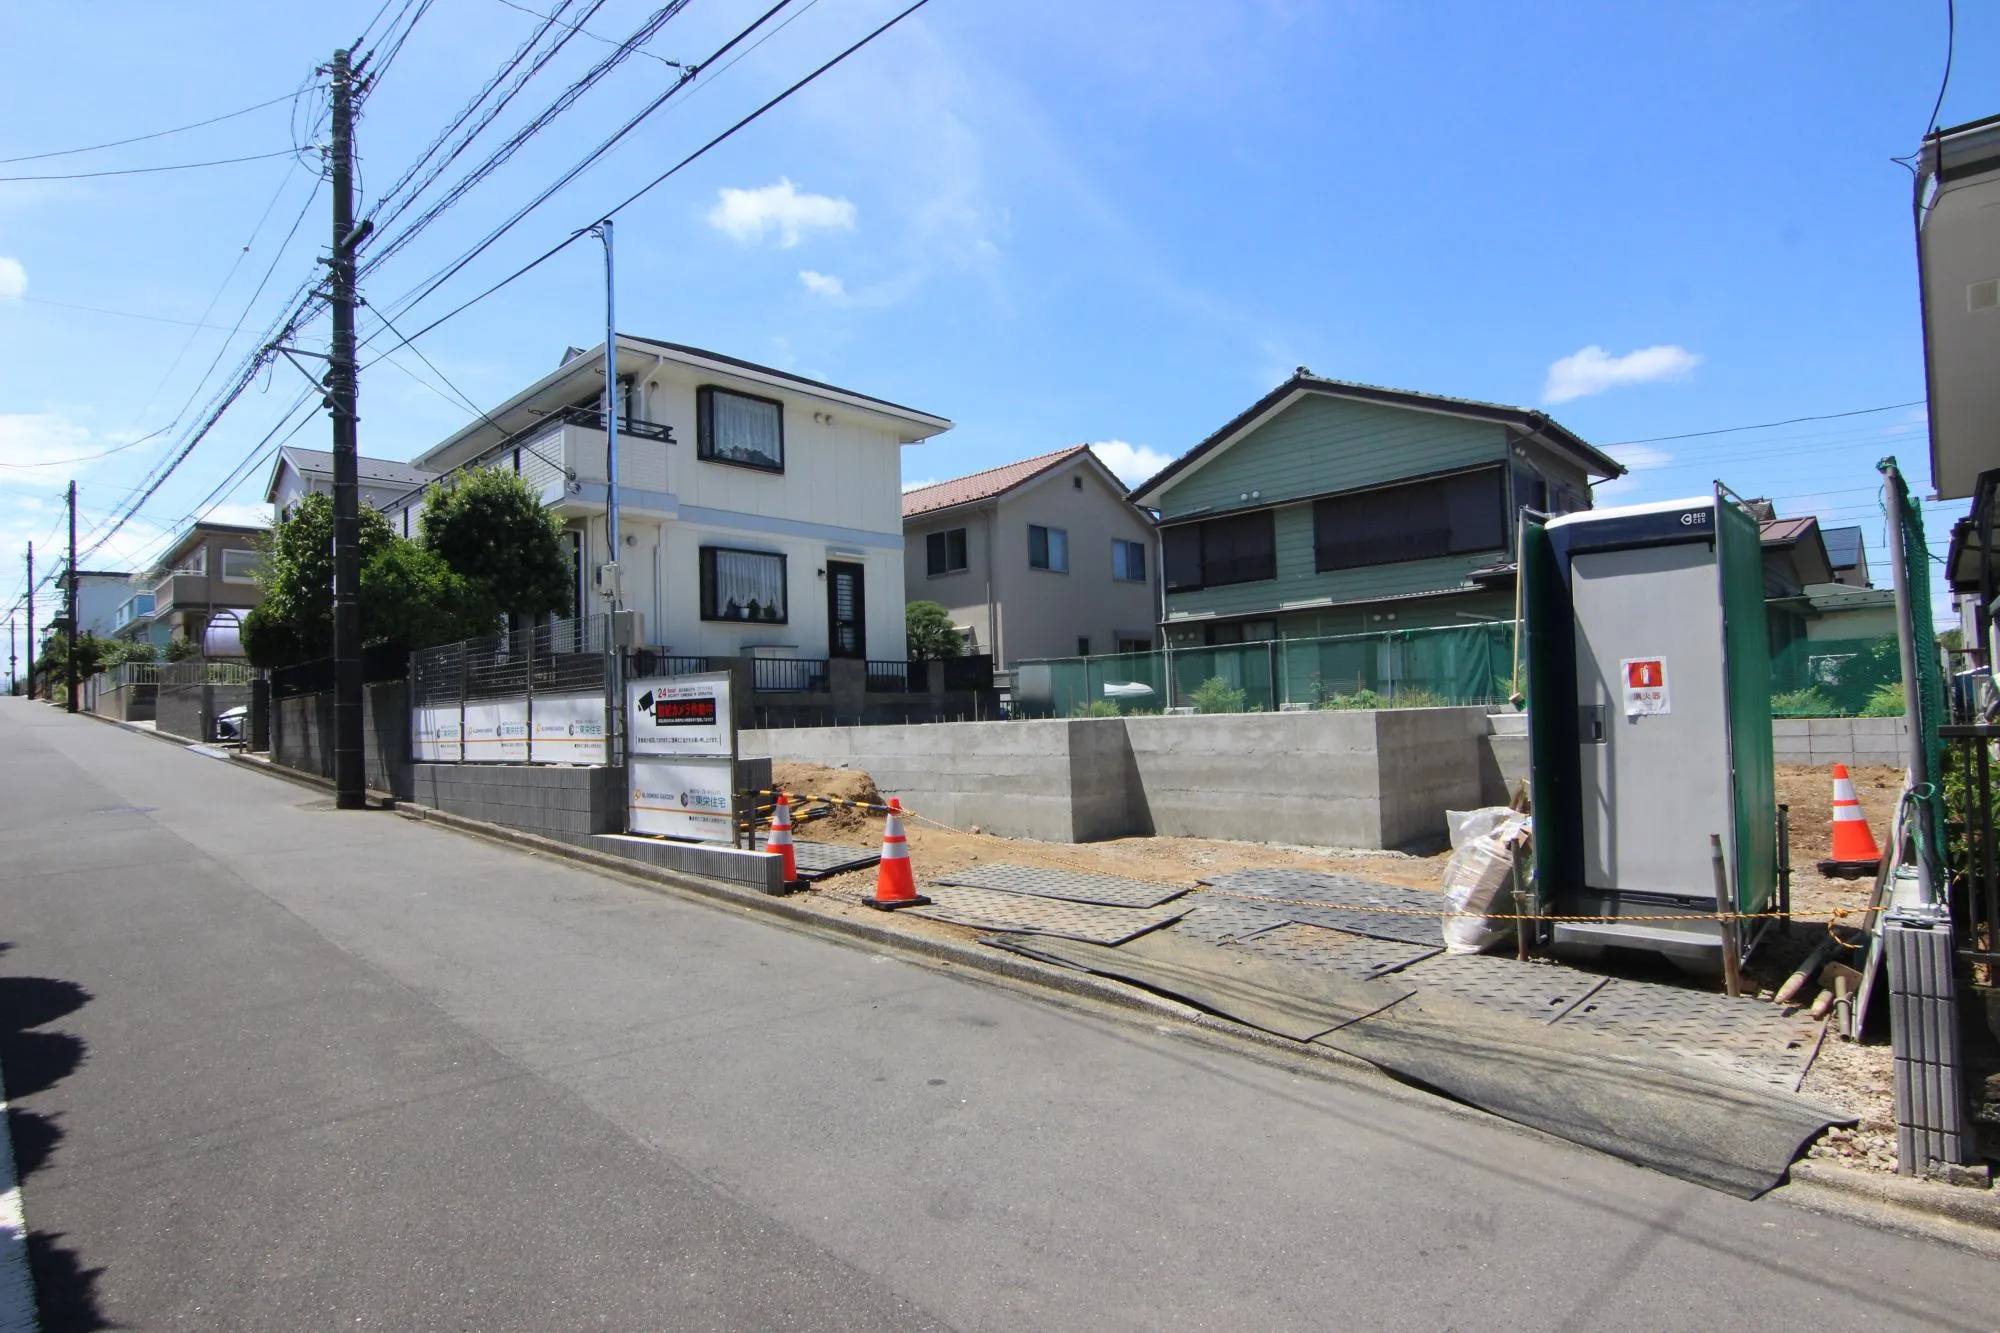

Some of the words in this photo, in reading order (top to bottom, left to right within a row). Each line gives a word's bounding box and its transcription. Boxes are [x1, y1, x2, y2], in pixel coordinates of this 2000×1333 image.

[658, 688, 667, 698] 24
[695, 795, 727, 808] 東栄住宅
